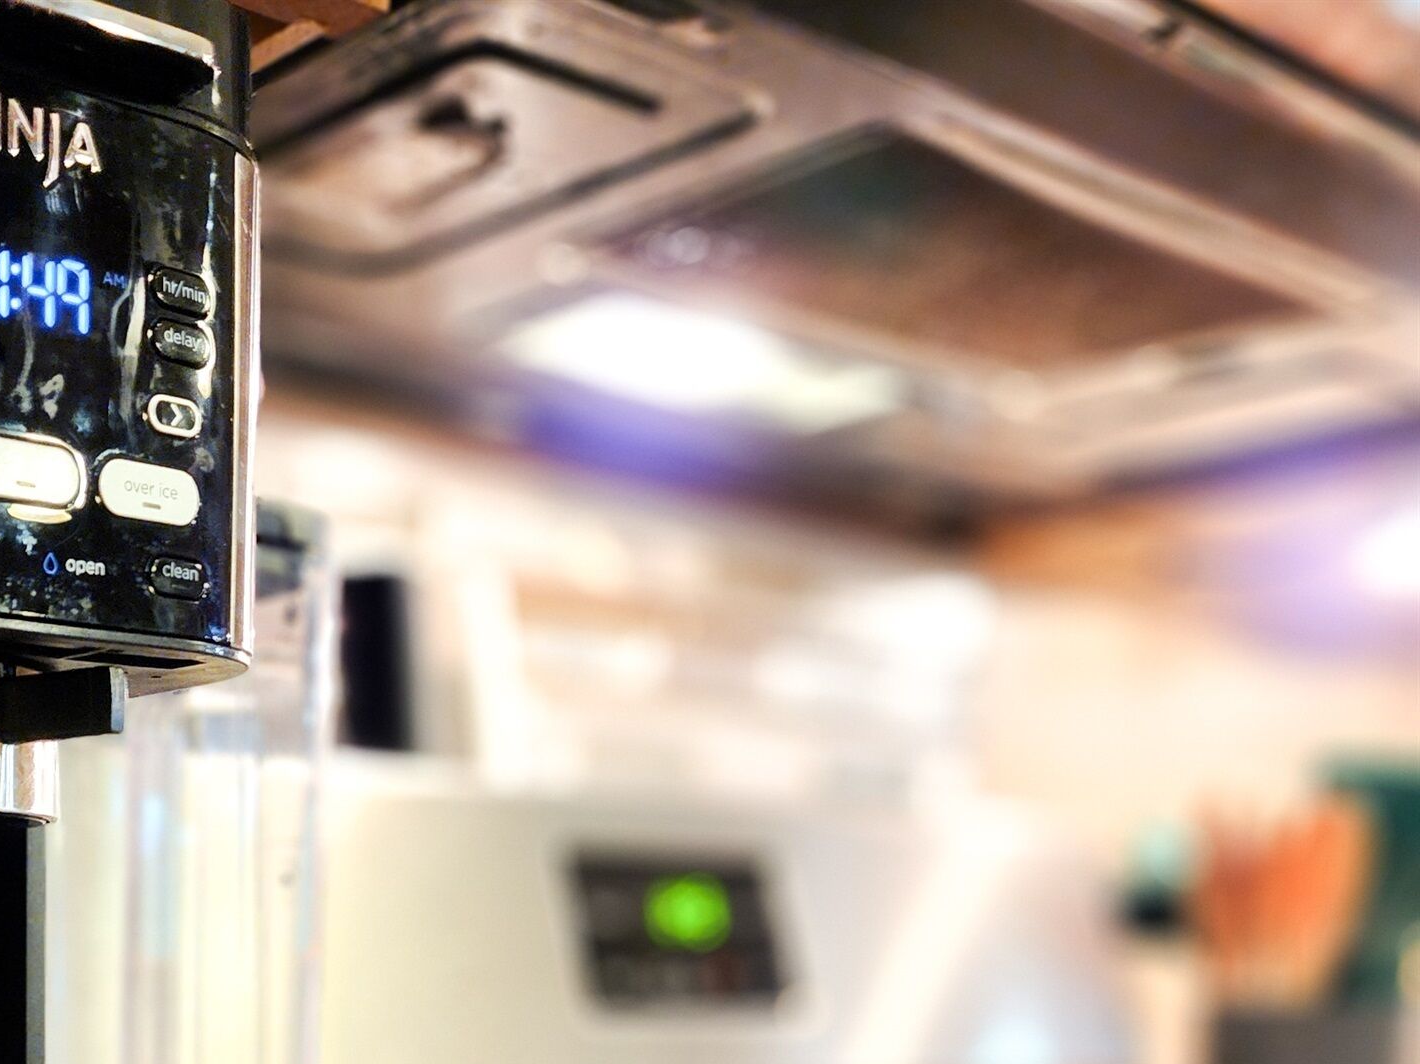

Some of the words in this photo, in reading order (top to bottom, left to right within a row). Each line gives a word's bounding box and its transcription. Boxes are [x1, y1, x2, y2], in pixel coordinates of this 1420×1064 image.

[162, 276, 207, 304] hr/min
[164, 327, 204, 351] delay
[123, 478, 155, 497] over
[158, 481, 178, 501] ice
[65, 557, 105, 577] open
[162, 562, 199, 582] clean
